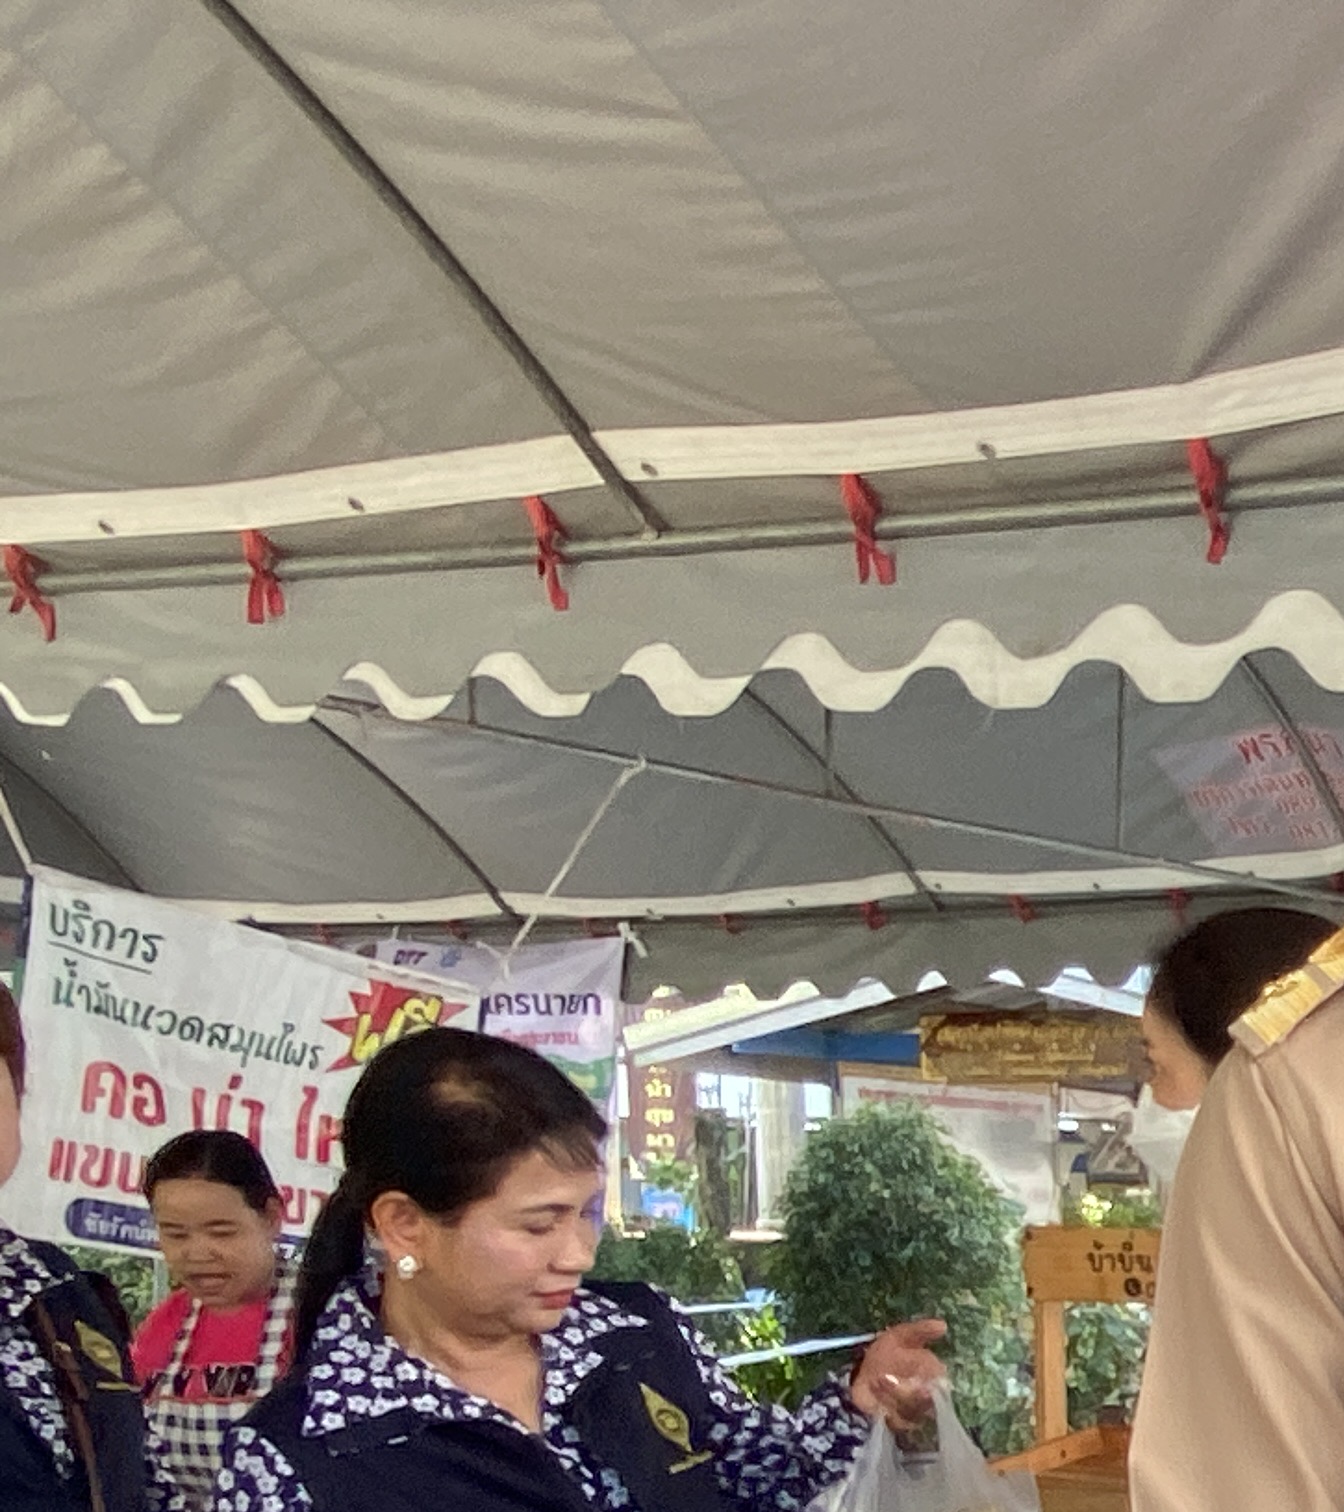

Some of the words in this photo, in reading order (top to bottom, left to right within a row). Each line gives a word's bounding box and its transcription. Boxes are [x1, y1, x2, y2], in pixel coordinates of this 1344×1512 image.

[49, 899, 165, 964] บริการ
[80, 1060, 168, 1128] คอ
